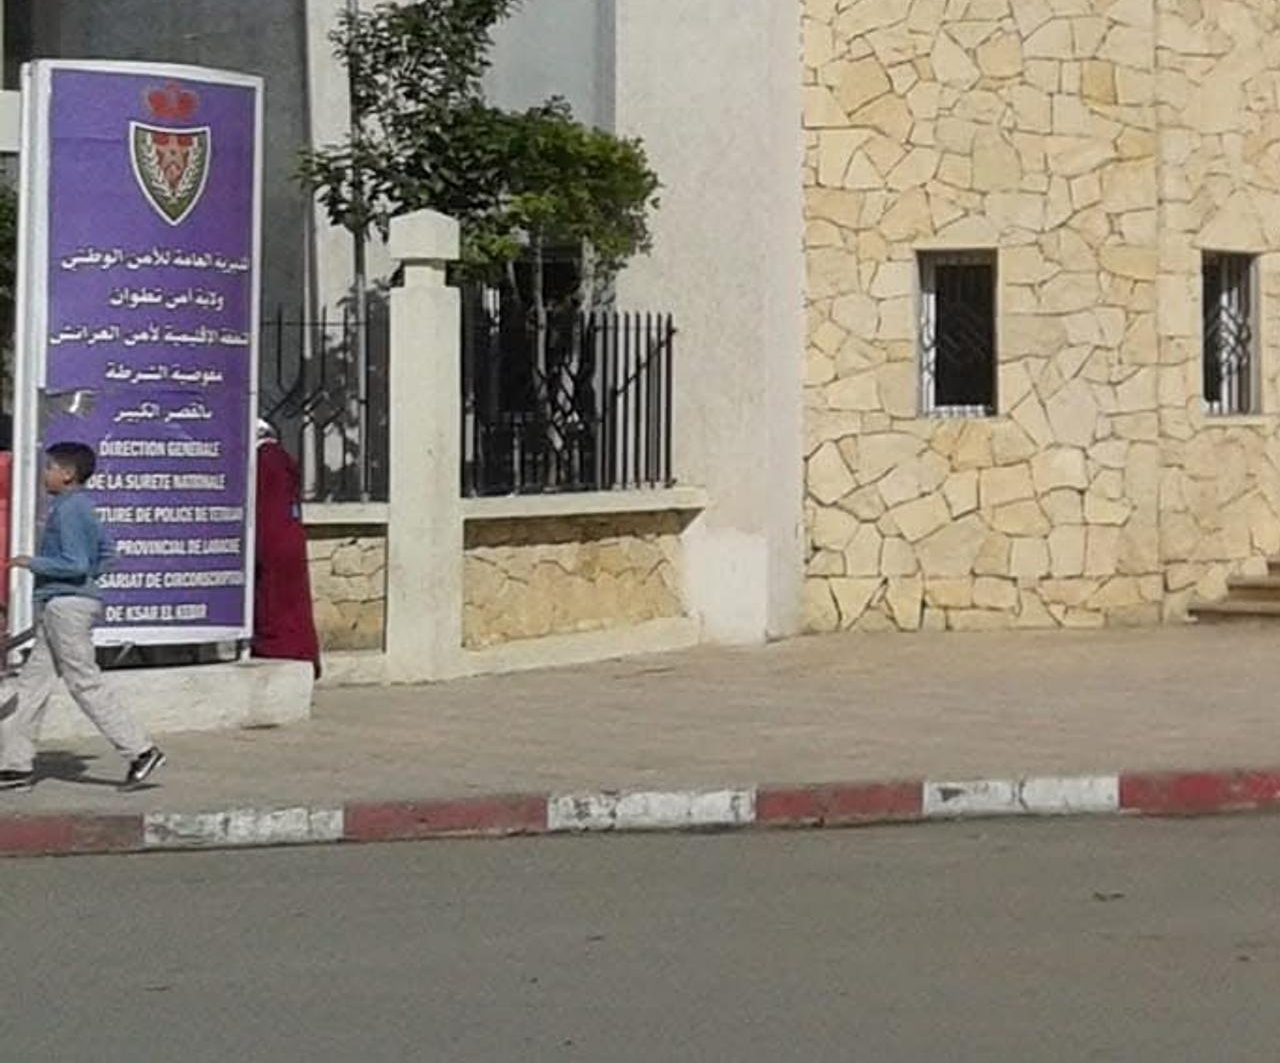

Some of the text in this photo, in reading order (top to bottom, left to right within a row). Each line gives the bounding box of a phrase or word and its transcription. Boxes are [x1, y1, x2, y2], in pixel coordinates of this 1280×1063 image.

[61, 248, 124, 272] الوطني
[109, 287, 162, 308] تطوان
[105, 362, 168, 384] الشرطة
[100, 440, 166, 457] DIRECTION
[107, 474, 123, 489] LA
[136, 506, 153, 522] DE
[154, 506, 194, 522] POLICE
[145, 572, 163, 588] DE
[105, 606, 124, 622] DE
